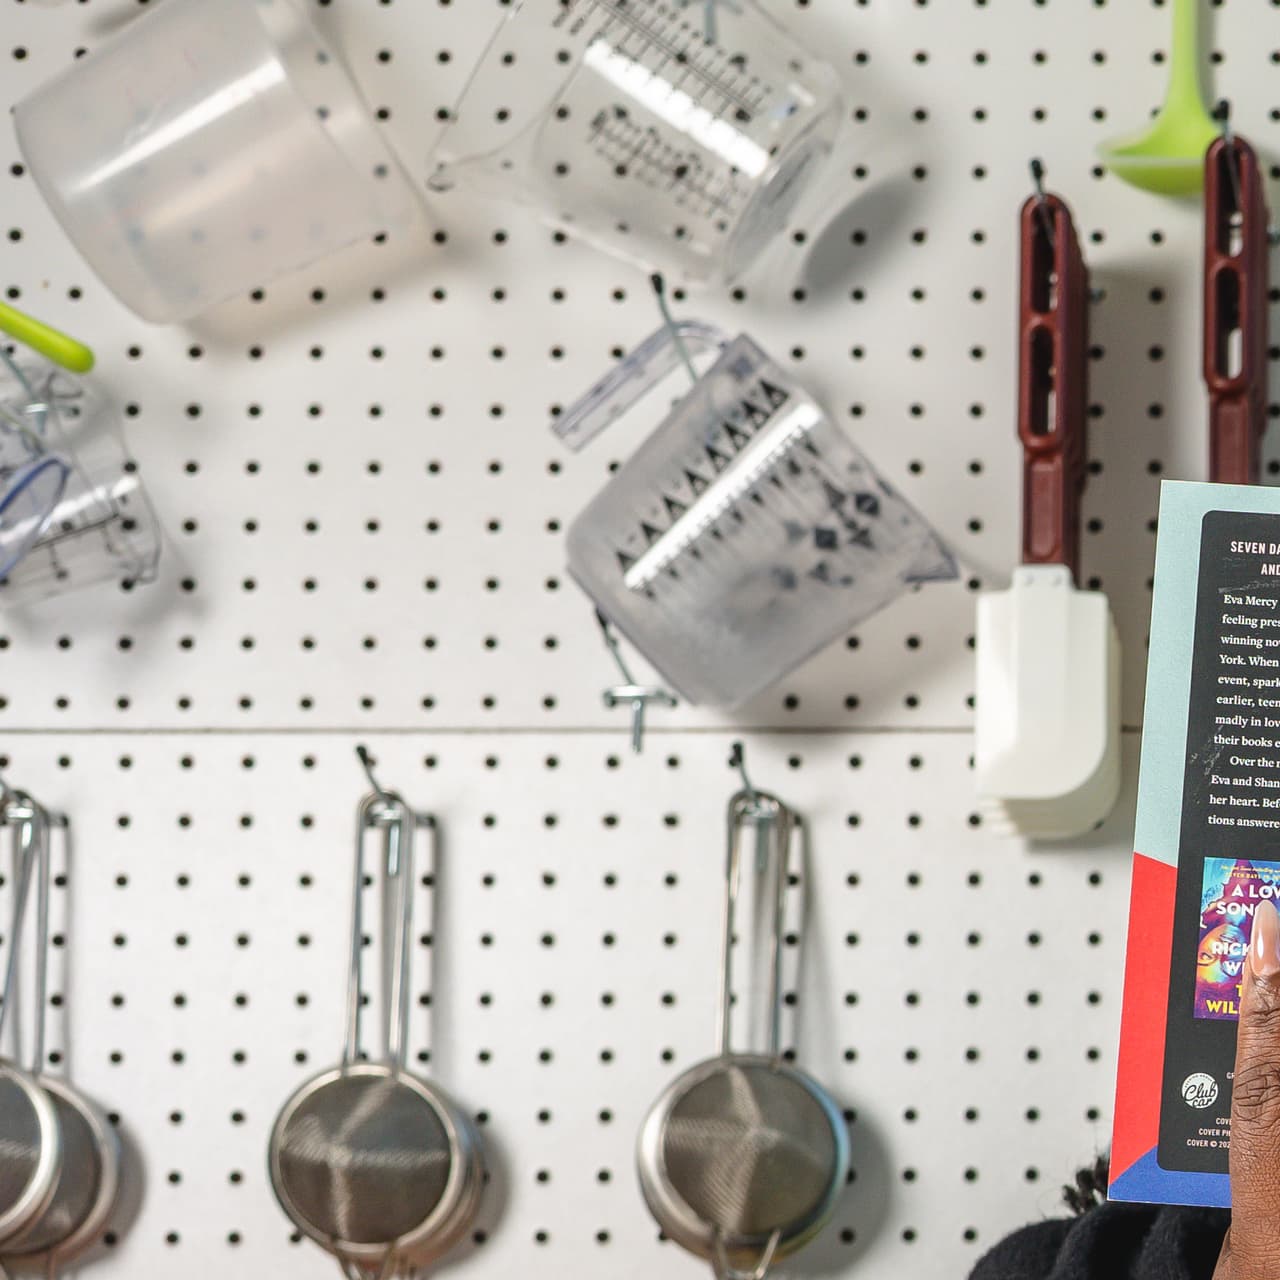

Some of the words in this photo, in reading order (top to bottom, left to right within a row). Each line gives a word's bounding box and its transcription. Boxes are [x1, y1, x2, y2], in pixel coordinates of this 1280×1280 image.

[1230, 541, 1266, 554] SEVEN
[1223, 594, 1243, 604] Eva
[1245, 595, 1278, 609] Mercy
[1213, 734, 1240, 745] their
[1241, 736, 1273, 747] books
[1208, 814, 1235, 825] tions
[1232, 885, 1243, 896] A
[1216, 902, 1256, 916] SON
[1184, 1085, 1217, 1100] Club
[1199, 1128, 1221, 1137] COVER
[1186, 1139, 1209, 1148] COVER
